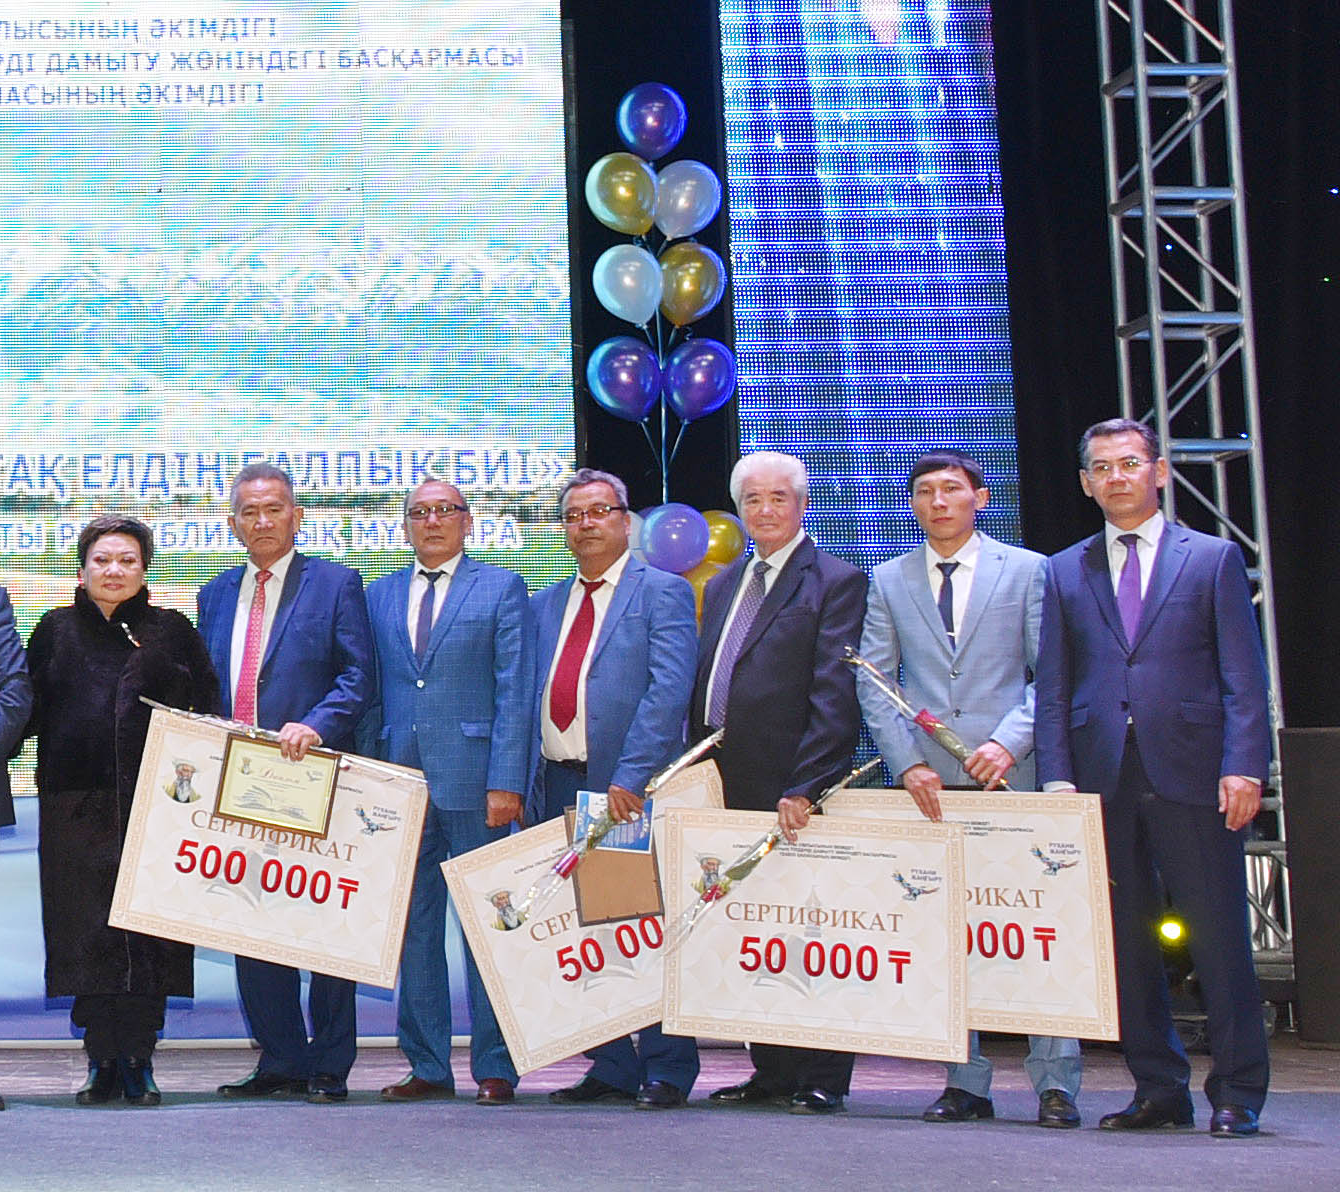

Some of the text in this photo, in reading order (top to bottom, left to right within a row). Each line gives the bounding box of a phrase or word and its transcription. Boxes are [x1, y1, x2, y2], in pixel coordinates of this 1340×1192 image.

[150, 17, 276, 41] ӘКІМДІГІ
[46, 51, 160, 75] ДАМЫТУ
[171, 50, 326, 73] ЖӨНІНДЕГІ
[338, 47, 524, 71] БАСҚАРМАСЫ
[136, 82, 264, 106] ӘКІМДІГІ
[83, 453, 224, 497] ЕЛДІҢ
[191, 809, 359, 862] СЕРТИФИКАТ
[174, 839, 247, 885] 500
[725, 901, 904, 932] СЕРТИФИКАТ
[556, 938, 605, 982] 50
[738, 936, 787, 974] 50
